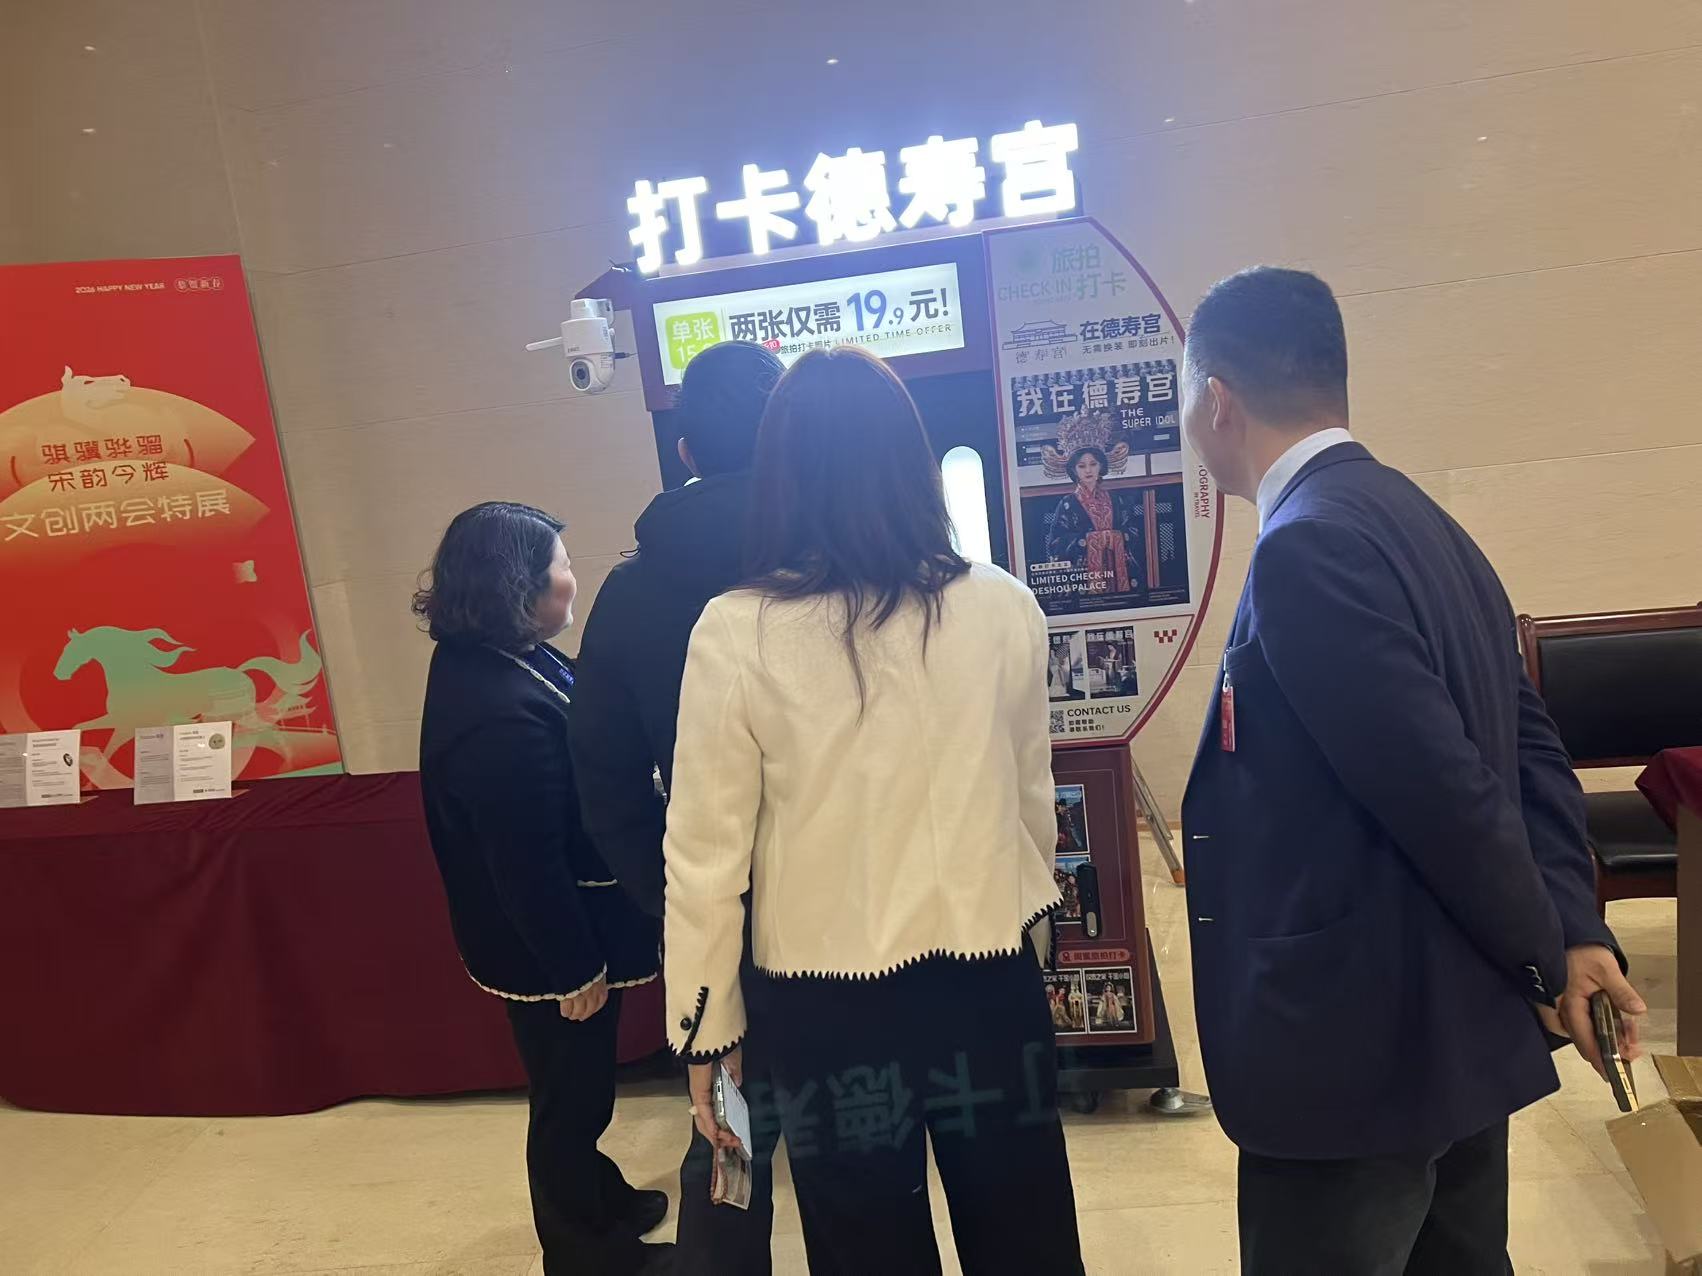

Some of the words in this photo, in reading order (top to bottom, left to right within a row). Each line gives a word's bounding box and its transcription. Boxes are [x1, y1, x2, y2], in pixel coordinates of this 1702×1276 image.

[626, 119, 1079, 273] 打卡德寿宫
[1051, 243, 1101, 273] 旅拍
[97, 284, 123, 293] HAPPY
[124, 283, 143, 291] NEW
[144, 281, 165, 290] YEAR
[998, 281, 1051, 302] CHECK
[1055, 277, 1071, 295] IN
[1076, 271, 1127, 300] 打卡
[672, 318, 715, 343] 单张
[835, 333, 880, 347] LIMITED
[884, 327, 911, 340] TIME
[916, 323, 952, 336] OFFER
[1079, 313, 1161, 342] 在德寿宫
[1017, 373, 1173, 417] 我在德寿宫
[1120, 408, 1144, 418] THE
[1122, 418, 1151, 429] SUPER
[1155, 415, 1176, 425] IDOL
[47, 461, 169, 492] 宋韵今辉
[0, 489, 231, 542] 文创两会特展
[1031, 574, 1068, 585] LIMITED
[1069, 570, 1114, 582] CHECK-IN
[1032, 584, 1072, 595] DESHOU
[1072, 581, 1107, 592] PALACE
[1067, 705, 1115, 717] CONTACT
[1116, 704, 1131, 713] US
